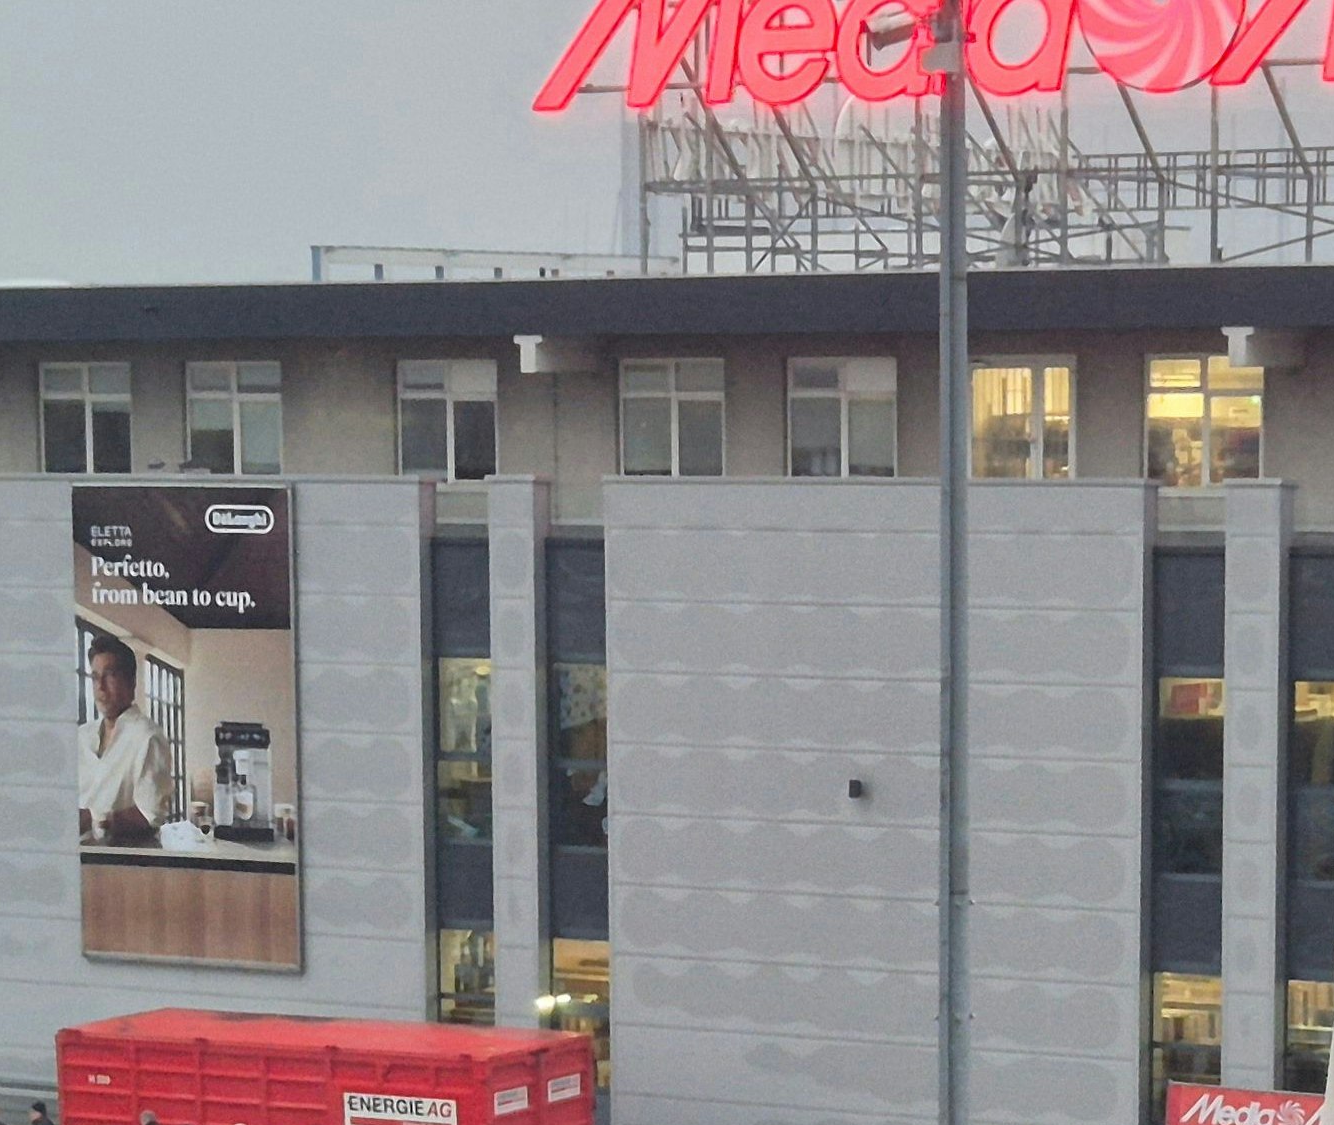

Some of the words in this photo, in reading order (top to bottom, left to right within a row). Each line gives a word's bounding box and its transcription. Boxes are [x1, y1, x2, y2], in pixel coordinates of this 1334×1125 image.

[531, 0, 1070, 112] Meda
[91, 554, 170, 579] Perfetto,
[91, 581, 139, 605] from
[142, 583, 188, 606] bean
[192, 588, 212, 606] to
[215, 590, 256, 613] cup.
[347, 1094, 425, 1117] ENERGIE
[427, 1101, 453, 1118] AG
